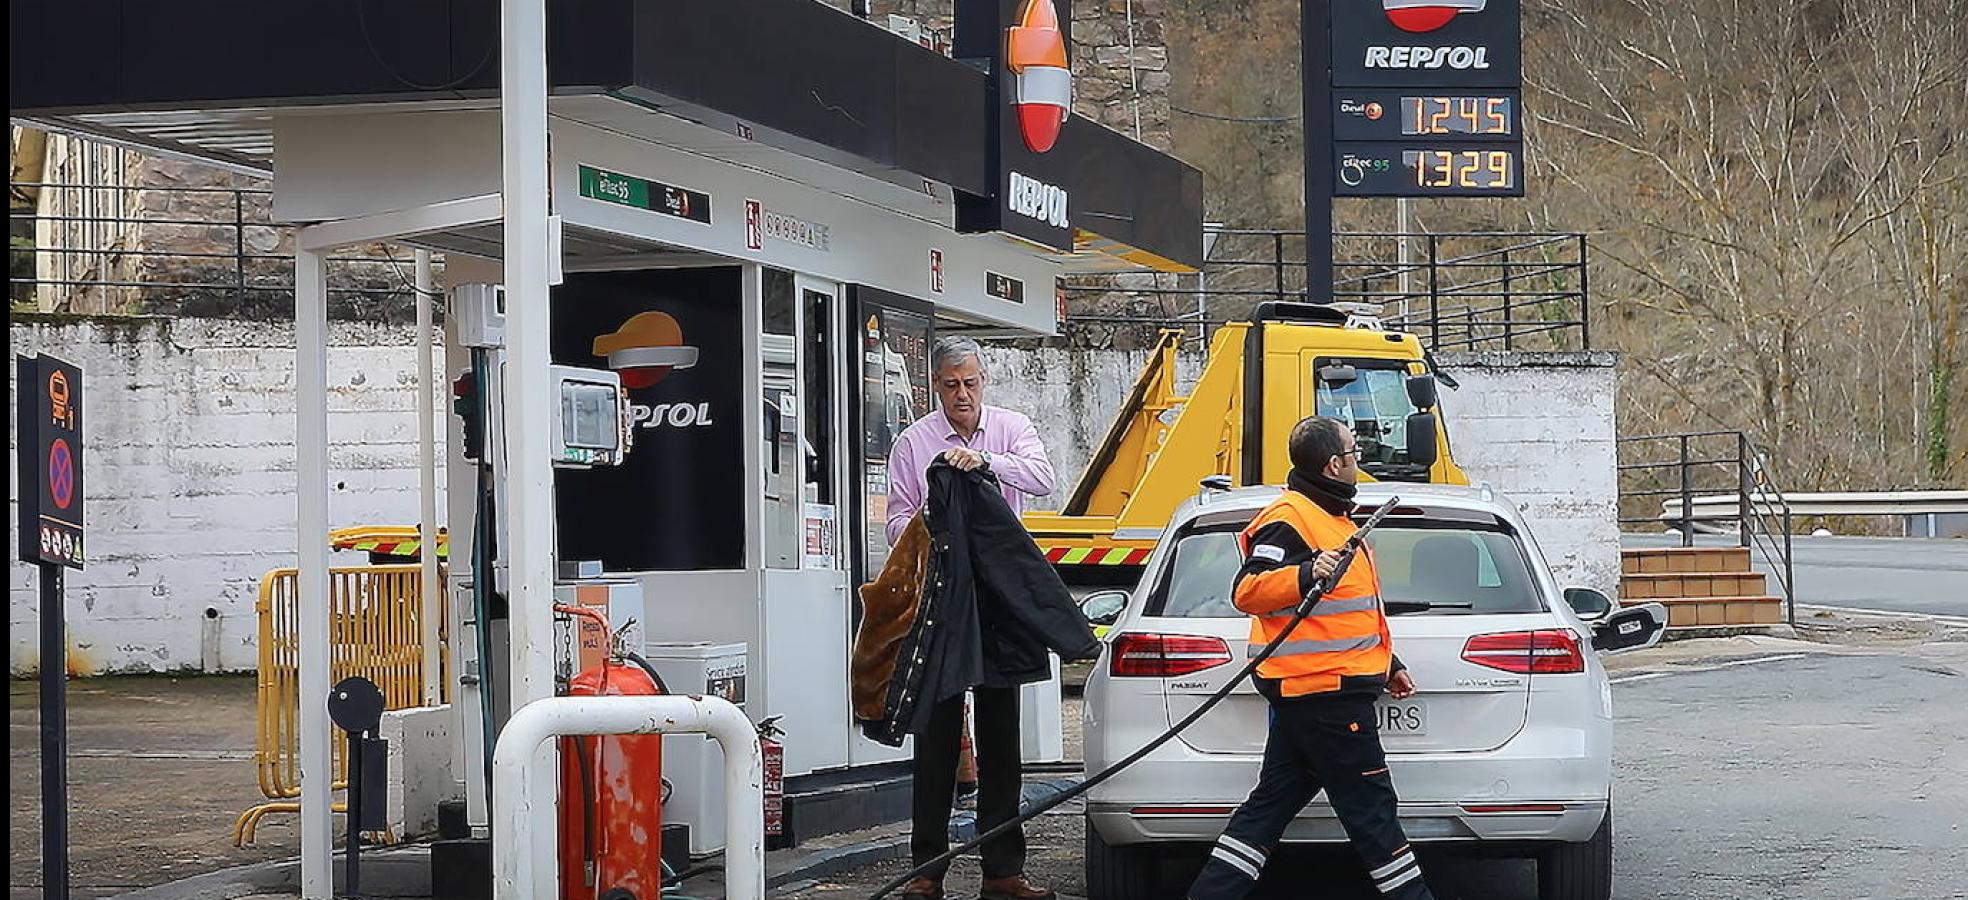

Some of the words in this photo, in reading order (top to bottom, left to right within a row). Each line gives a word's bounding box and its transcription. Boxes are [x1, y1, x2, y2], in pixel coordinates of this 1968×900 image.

[1364, 46, 1490, 69] REPSOL
[1415, 97, 1505, 134] 1.245
[1373, 159, 1391, 172] 95
[1417, 151, 1508, 187] 1.329
[1009, 171, 1069, 229] REPSOL
[630, 402, 713, 430] PSOL
